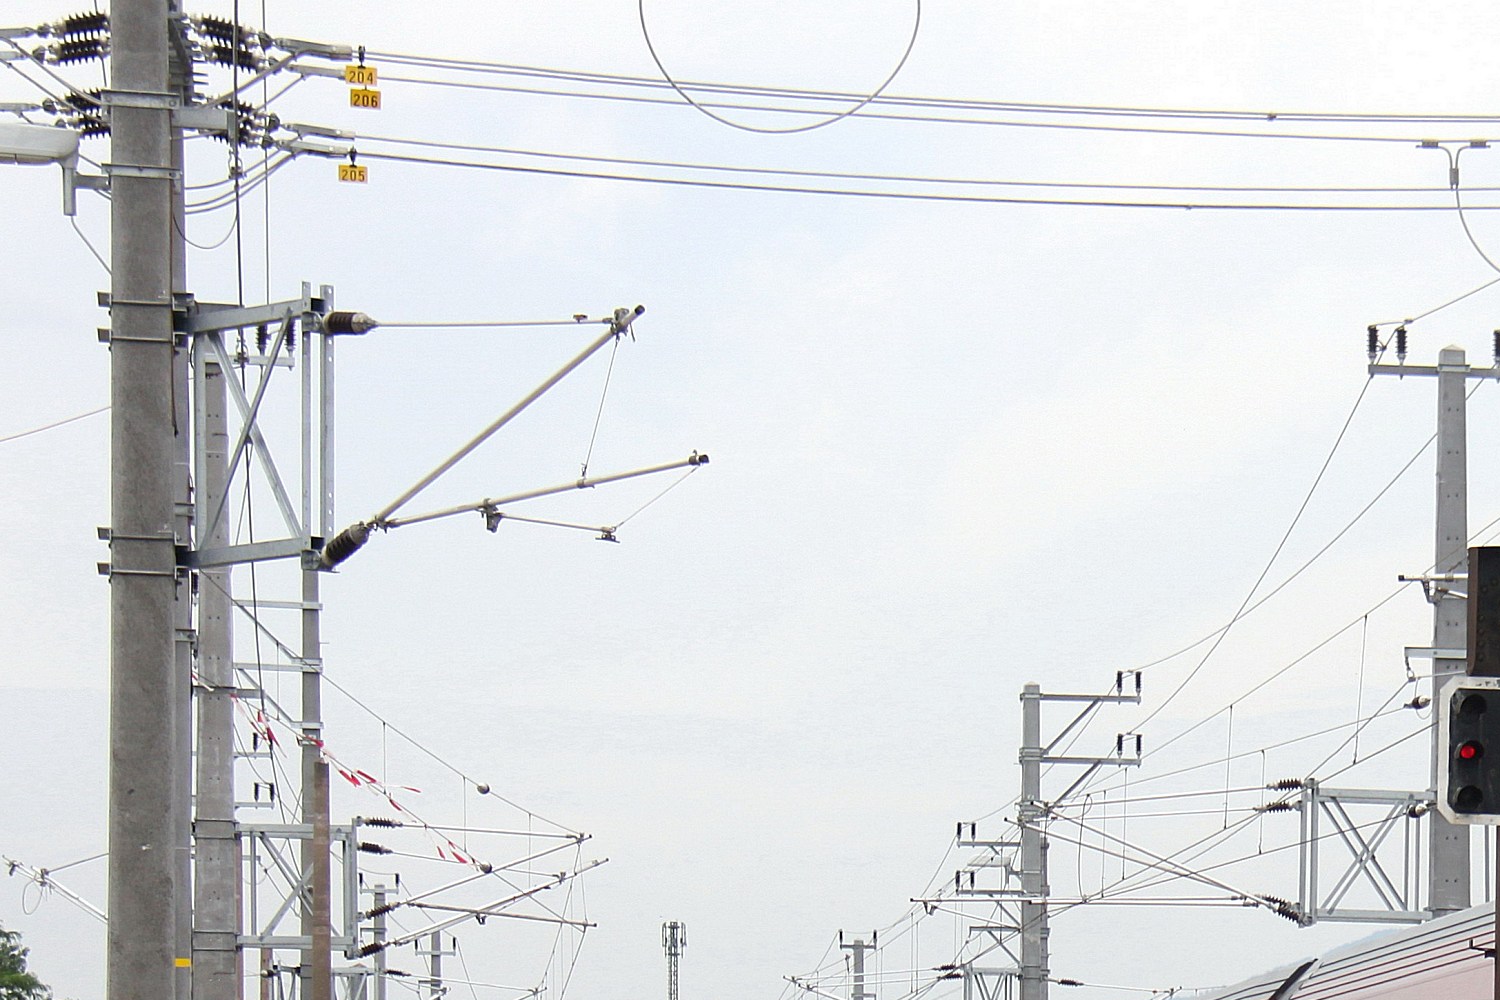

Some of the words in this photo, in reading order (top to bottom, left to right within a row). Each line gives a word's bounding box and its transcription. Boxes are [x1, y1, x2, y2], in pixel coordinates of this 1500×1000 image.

[349, 70, 373, 84] 204
[353, 93, 378, 108] 206
[341, 169, 365, 182] 205
